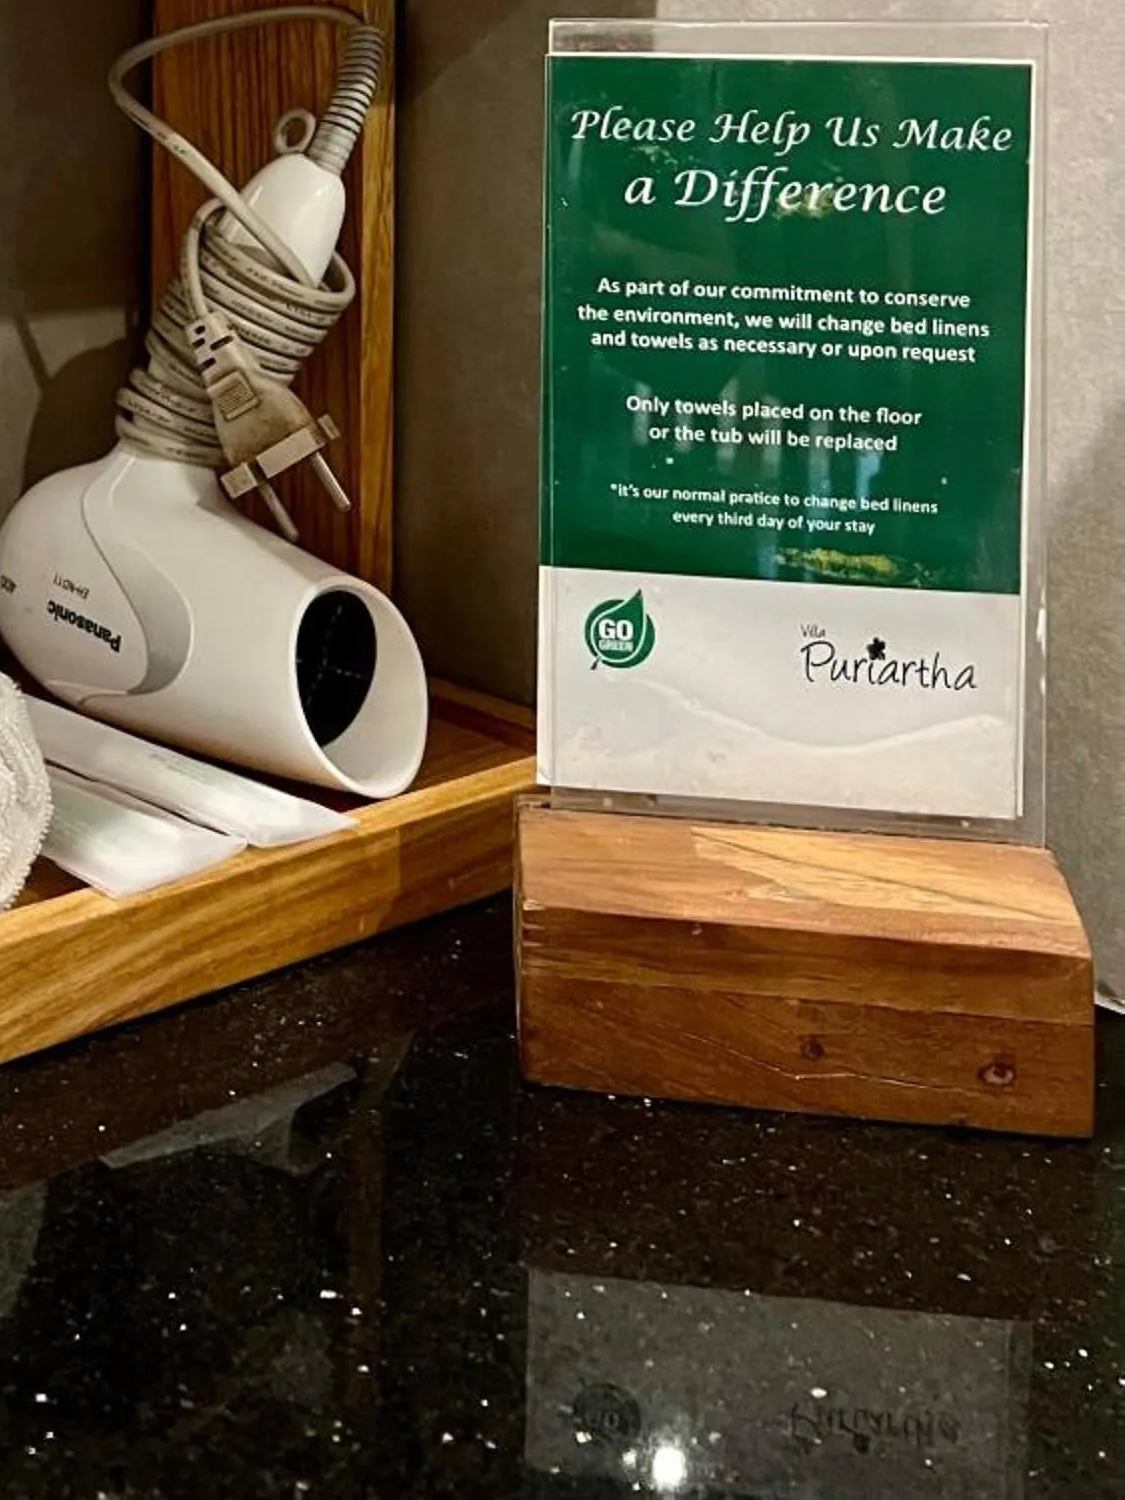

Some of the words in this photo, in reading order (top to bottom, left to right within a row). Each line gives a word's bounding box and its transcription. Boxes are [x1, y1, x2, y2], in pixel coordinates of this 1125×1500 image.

[570, 105, 696, 142] Please
[708, 109, 811, 157] Help
[825, 116, 881, 147] Us
[892, 115, 1013, 151] Make
[624, 176, 657, 205] a
[674, 165, 947, 223] Difference
[597, 277, 620, 293] As
[626, 280, 665, 298] part
[669, 280, 690, 297] of
[693, 284, 727, 298] our
[731, 285, 854, 304] commitment
[858, 288, 880, 304] to
[884, 291, 971, 308] conserve
[577, 303, 609, 321] the
[613, 306, 740, 329] environment,
[744, 314, 774, 329] we
[778, 313, 812, 330] will
[817, 314, 886, 337] change
[890, 316, 927, 335] bed
[932, 318, 991, 338] linens
[590, 330, 626, 347] and
[631, 331, 694, 350] towels
[698, 336, 719, 351] as
[724, 337, 817, 359] necessary
[821, 341, 843, 357] or
[848, 343, 898, 361] upon
[902, 346, 976, 365] request
[625, 395, 669, 417] Only
[674, 398, 737, 417] towels
[742, 401, 804, 420] placed
[809, 407, 835, 422] on
[838, 405, 871, 424] the
[876, 407, 923, 426] floor
[648, 426, 670, 440] or
[674, 425, 706, 442] the
[710, 426, 743, 444] tub
[747, 428, 782, 446] will
[787, 430, 810, 447] be
[815, 434, 898, 453] replaced
[643, 487, 669, 501] our
[672, 487, 726, 504] normal
[729, 490, 780, 508] pratice
[784, 493, 800, 507] to
[804, 494, 857, 512] change
[860, 496, 889, 512] bed
[892, 497, 938, 515] linens
[672, 511, 714, 528] every
[717, 510, 753, 528] third
[756, 512, 784, 531] day
[788, 514, 804, 530] of
[806, 518, 841, 534] your
[844, 520, 876, 536] stay
[46, 599, 123, 653] Panasonic
[598, 617, 634, 641] GO
[799, 638, 978, 691] Puriartha
